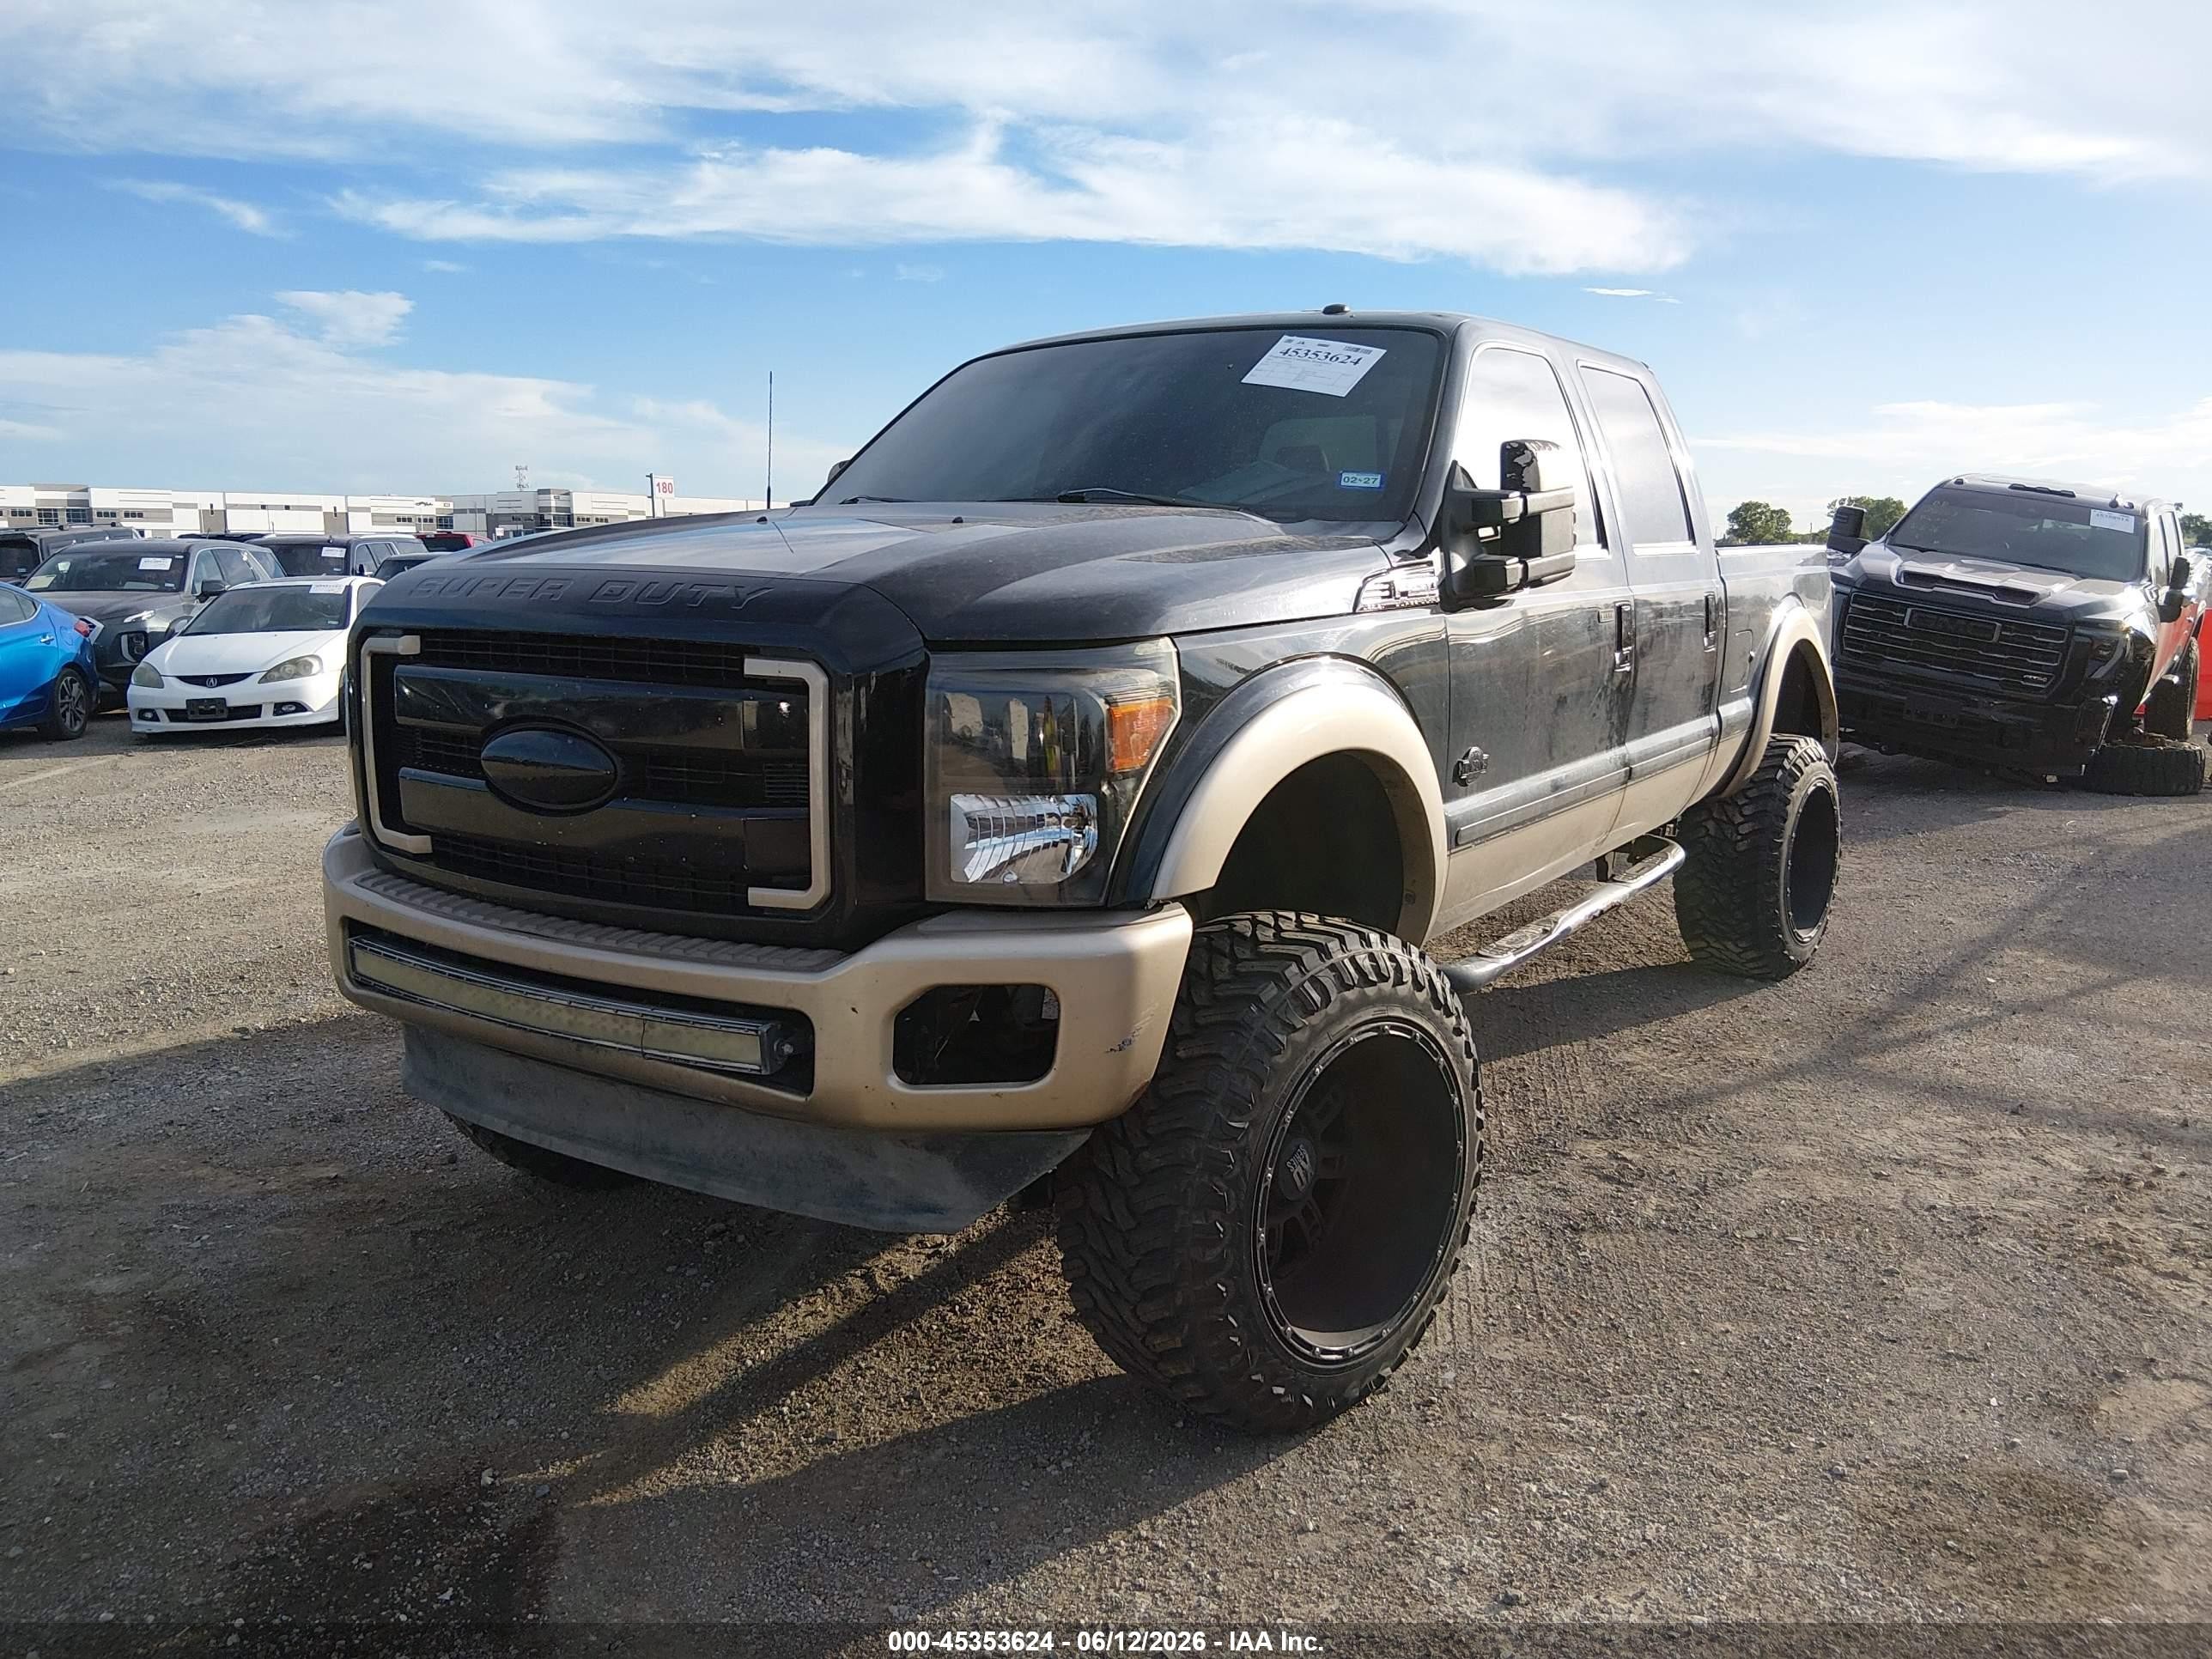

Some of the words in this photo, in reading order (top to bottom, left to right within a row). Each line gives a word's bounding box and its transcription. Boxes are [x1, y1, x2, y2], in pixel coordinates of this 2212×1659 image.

[1279, 346, 1364, 366] 45353624
[656, 482, 674, 494] 180
[410, 577, 575, 601] SUPER
[588, 580, 776, 611] DUTY
[1285, 1144, 1307, 1173] SERIES
